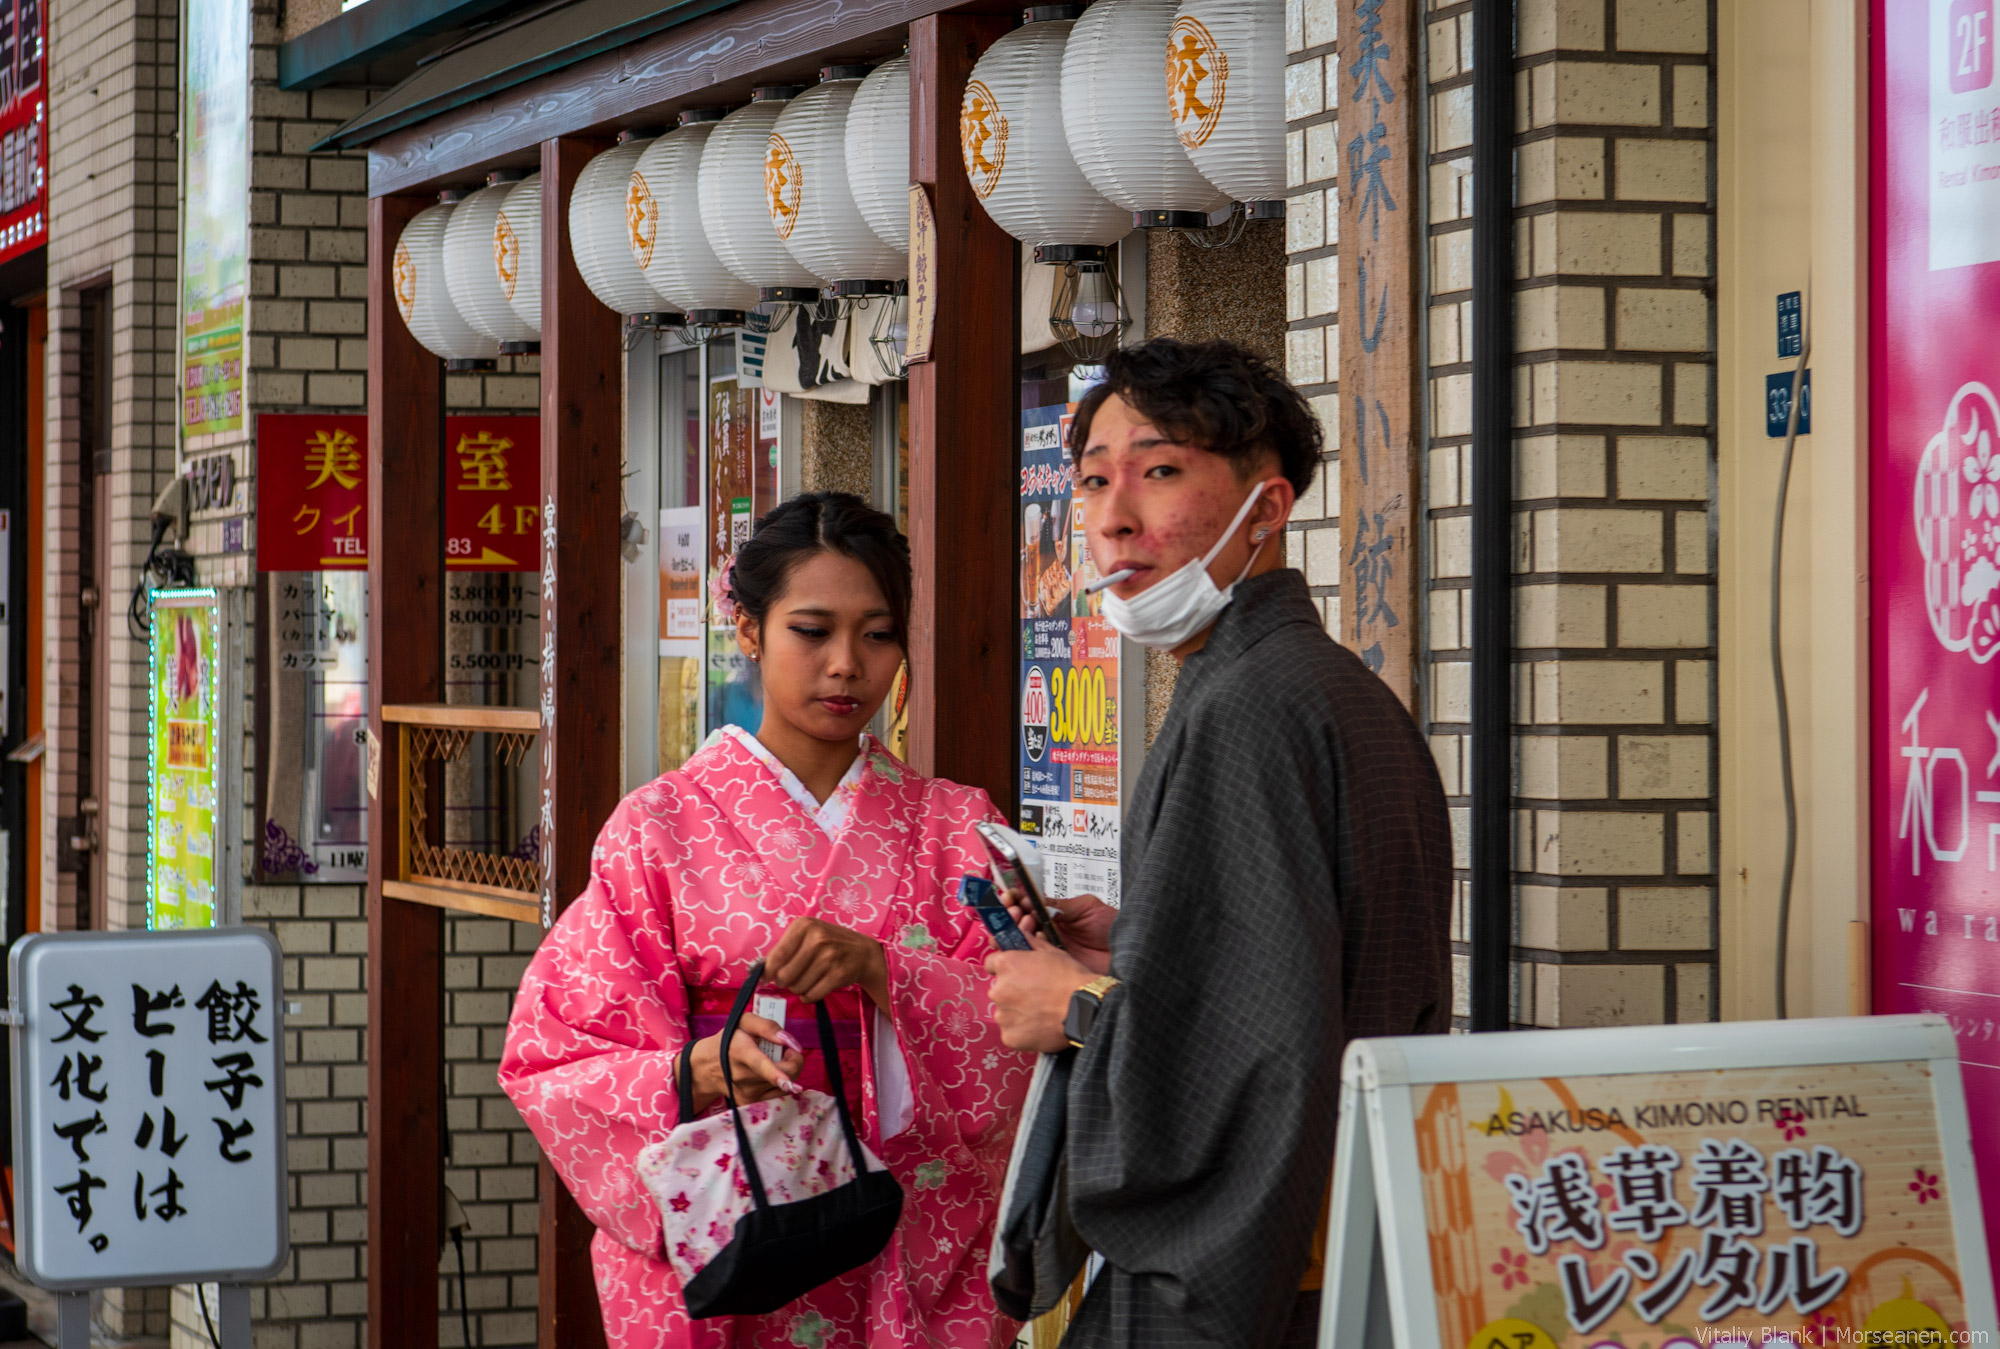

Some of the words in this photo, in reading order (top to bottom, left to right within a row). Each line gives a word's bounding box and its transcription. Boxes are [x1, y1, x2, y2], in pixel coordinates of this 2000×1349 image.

[1957, 11, 1987, 76] 2F
[303, 428, 361, 491] 美
[456, 431, 515, 491] 室
[477, 503, 540, 536] 4F
[332, 537, 366, 555] TEL
[283, 585, 335, 600] カット
[283, 653, 336, 669] カラー
[1024, 690, 1044, 724] 400
[1050, 666, 1106, 744] 3,000
[355, 731, 366, 744] 8
[331, 851, 368, 868] 日曜
[194, 979, 268, 1163] 餃子と
[49, 983, 109, 1254] 文化です。
[130, 983, 189, 1222] ビールは
[1485, 1107, 1628, 1136] ASAKUSA
[1635, 1100, 1749, 1128] KIMONO
[1756, 1094, 1868, 1121] RENTAL
[1505, 1138, 1863, 1256] 浅草着物
[1559, 1232, 1848, 1333] レンタル
